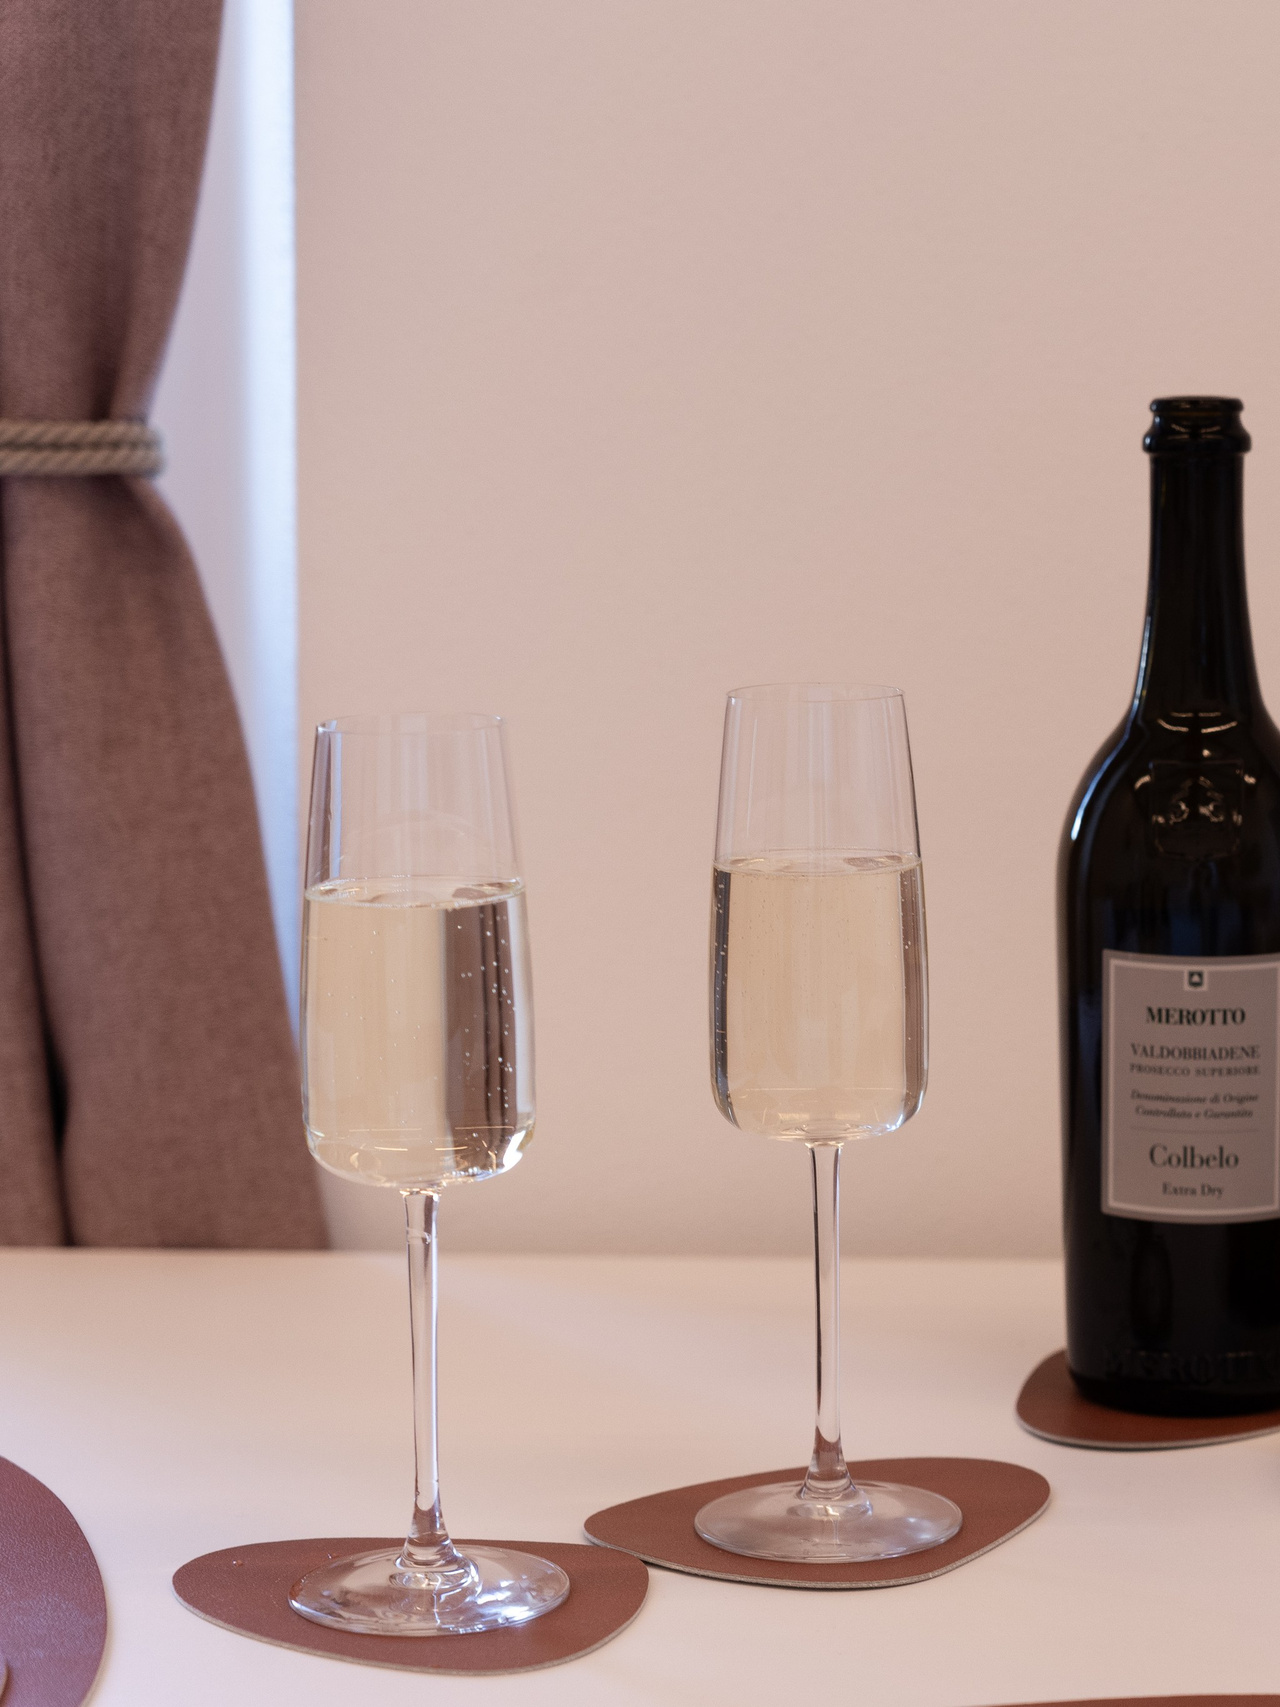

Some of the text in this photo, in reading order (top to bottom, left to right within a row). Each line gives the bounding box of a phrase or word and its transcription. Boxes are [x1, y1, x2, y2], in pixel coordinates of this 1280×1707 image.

[1146, 1006, 1246, 1025] MEROTTO
[1130, 1042, 1261, 1060] VALDOBBIADENE
[1129, 1062, 1260, 1077] PROSECCO SUPERIORE
[1149, 1142, 1239, 1168] Colbelo
[1162, 1182, 1223, 1199] Extra Dry
